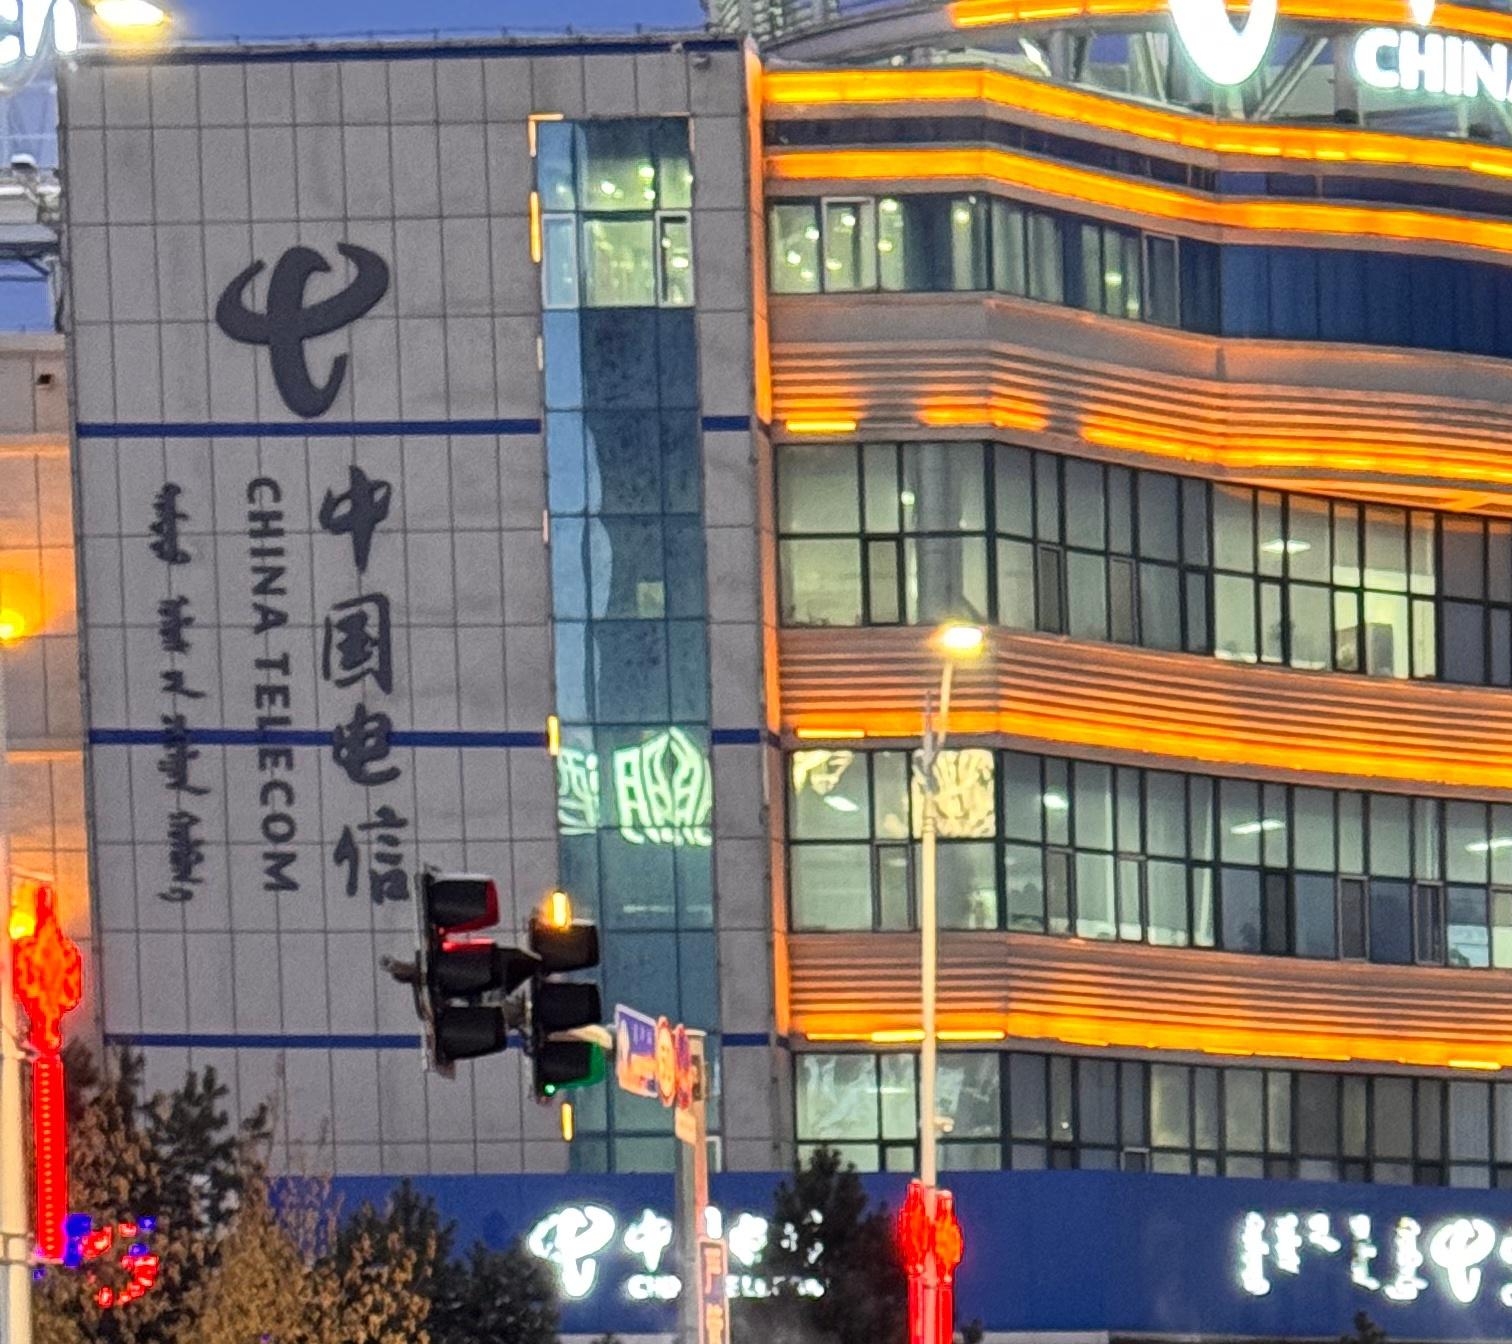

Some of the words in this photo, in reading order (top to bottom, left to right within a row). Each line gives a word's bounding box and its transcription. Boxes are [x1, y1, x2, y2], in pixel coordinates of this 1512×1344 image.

[246, 477, 288, 634] CHINA
[254, 653, 299, 892] TELECOM
[320, 465, 410, 904] 中国电信
